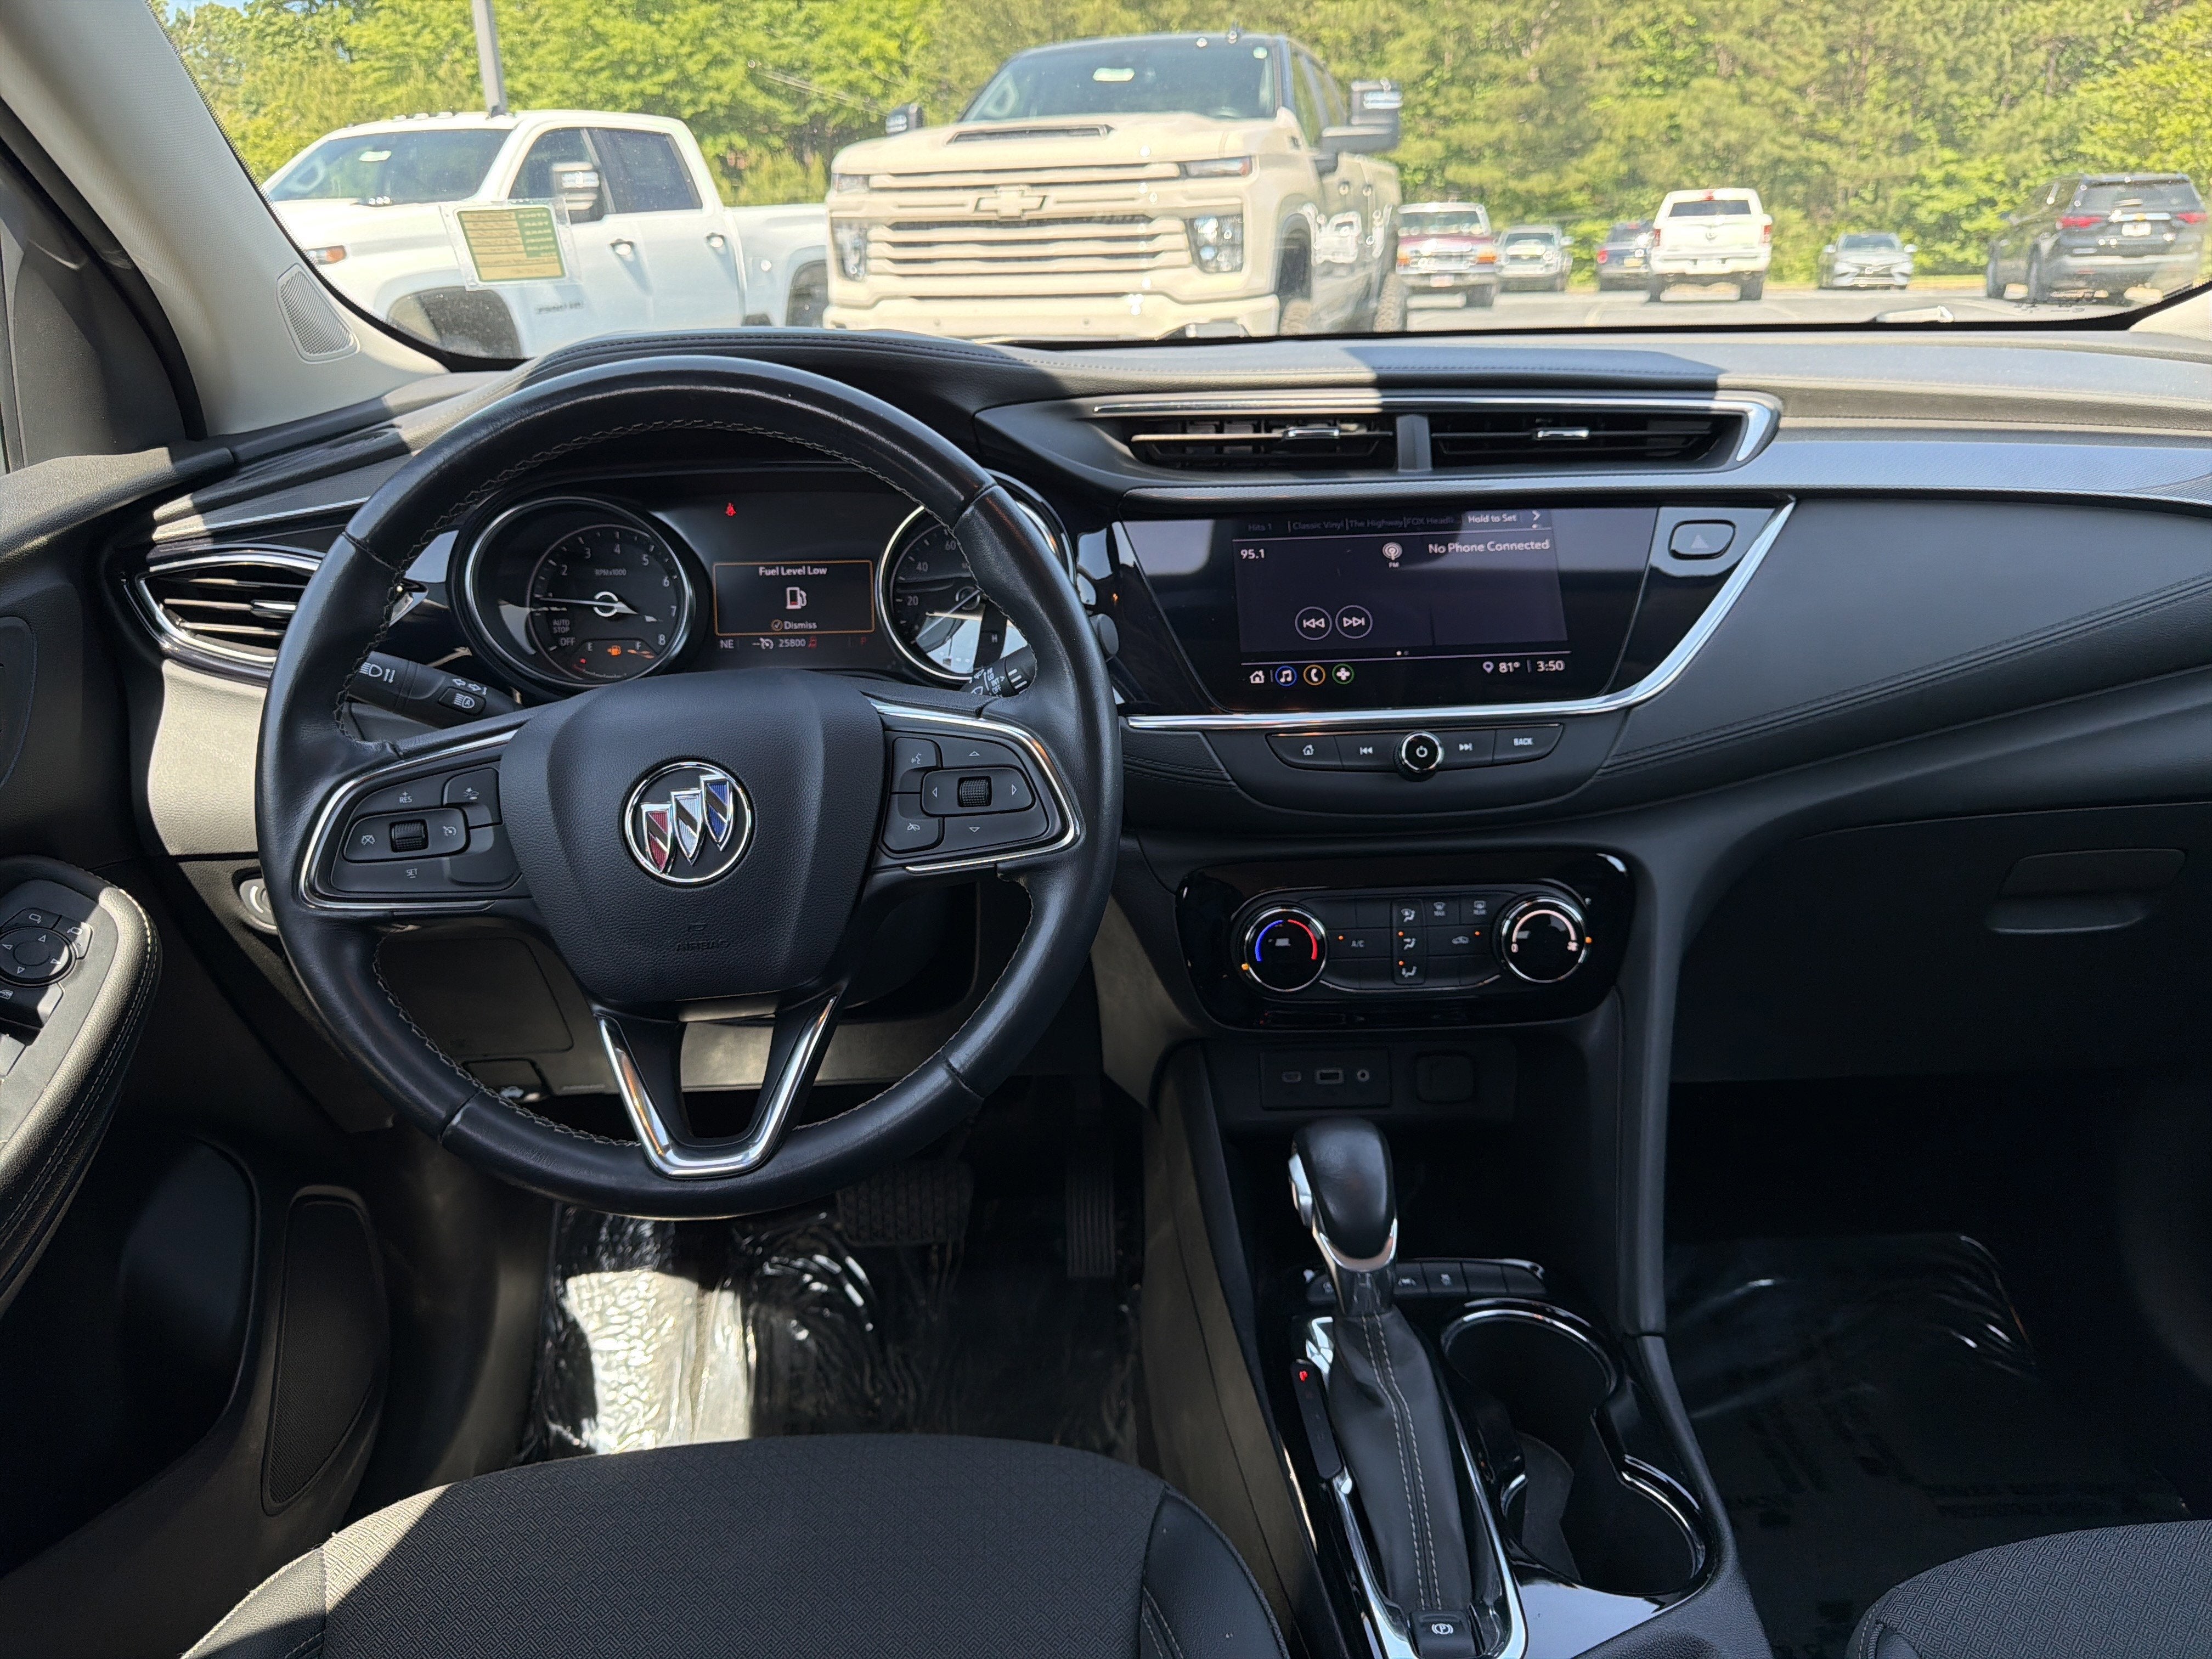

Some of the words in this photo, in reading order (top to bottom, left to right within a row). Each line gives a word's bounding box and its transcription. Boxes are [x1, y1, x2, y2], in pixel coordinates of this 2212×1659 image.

[1468, 515, 1489, 523] Hold
[1502, 514, 1516, 522] Set
[614, 543, 620, 555] 4
[1428, 543, 1446, 554] No
[1447, 542, 1485, 552] Phone
[1487, 539, 1550, 551] Connected
[584, 547, 591, 559] 3
[1240, 549, 1265, 559] 95.1
[642, 554, 649, 566] 5
[561, 564, 568, 576] 2
[759, 567, 779, 577] Fuel
[780, 567, 806, 576] Level
[807, 567, 828, 575] Low
[916, 562, 928, 572] 40
[662, 577, 670, 588] 6
[907, 596, 919, 606] 20
[670, 605, 676, 617] 7
[783, 620, 817, 630] Dismiss
[560, 637, 576, 646] OFF
[659, 634, 665, 646] 8
[719, 639, 734, 649] NE
[778, 639, 806, 648] 25800
[588, 642, 593, 652] E
[1536, 659, 1565, 672] 3:50
[1514, 737, 1533, 746] BACK
[406, 868, 418, 877] SET
[1351, 940, 1365, 948] A/C
